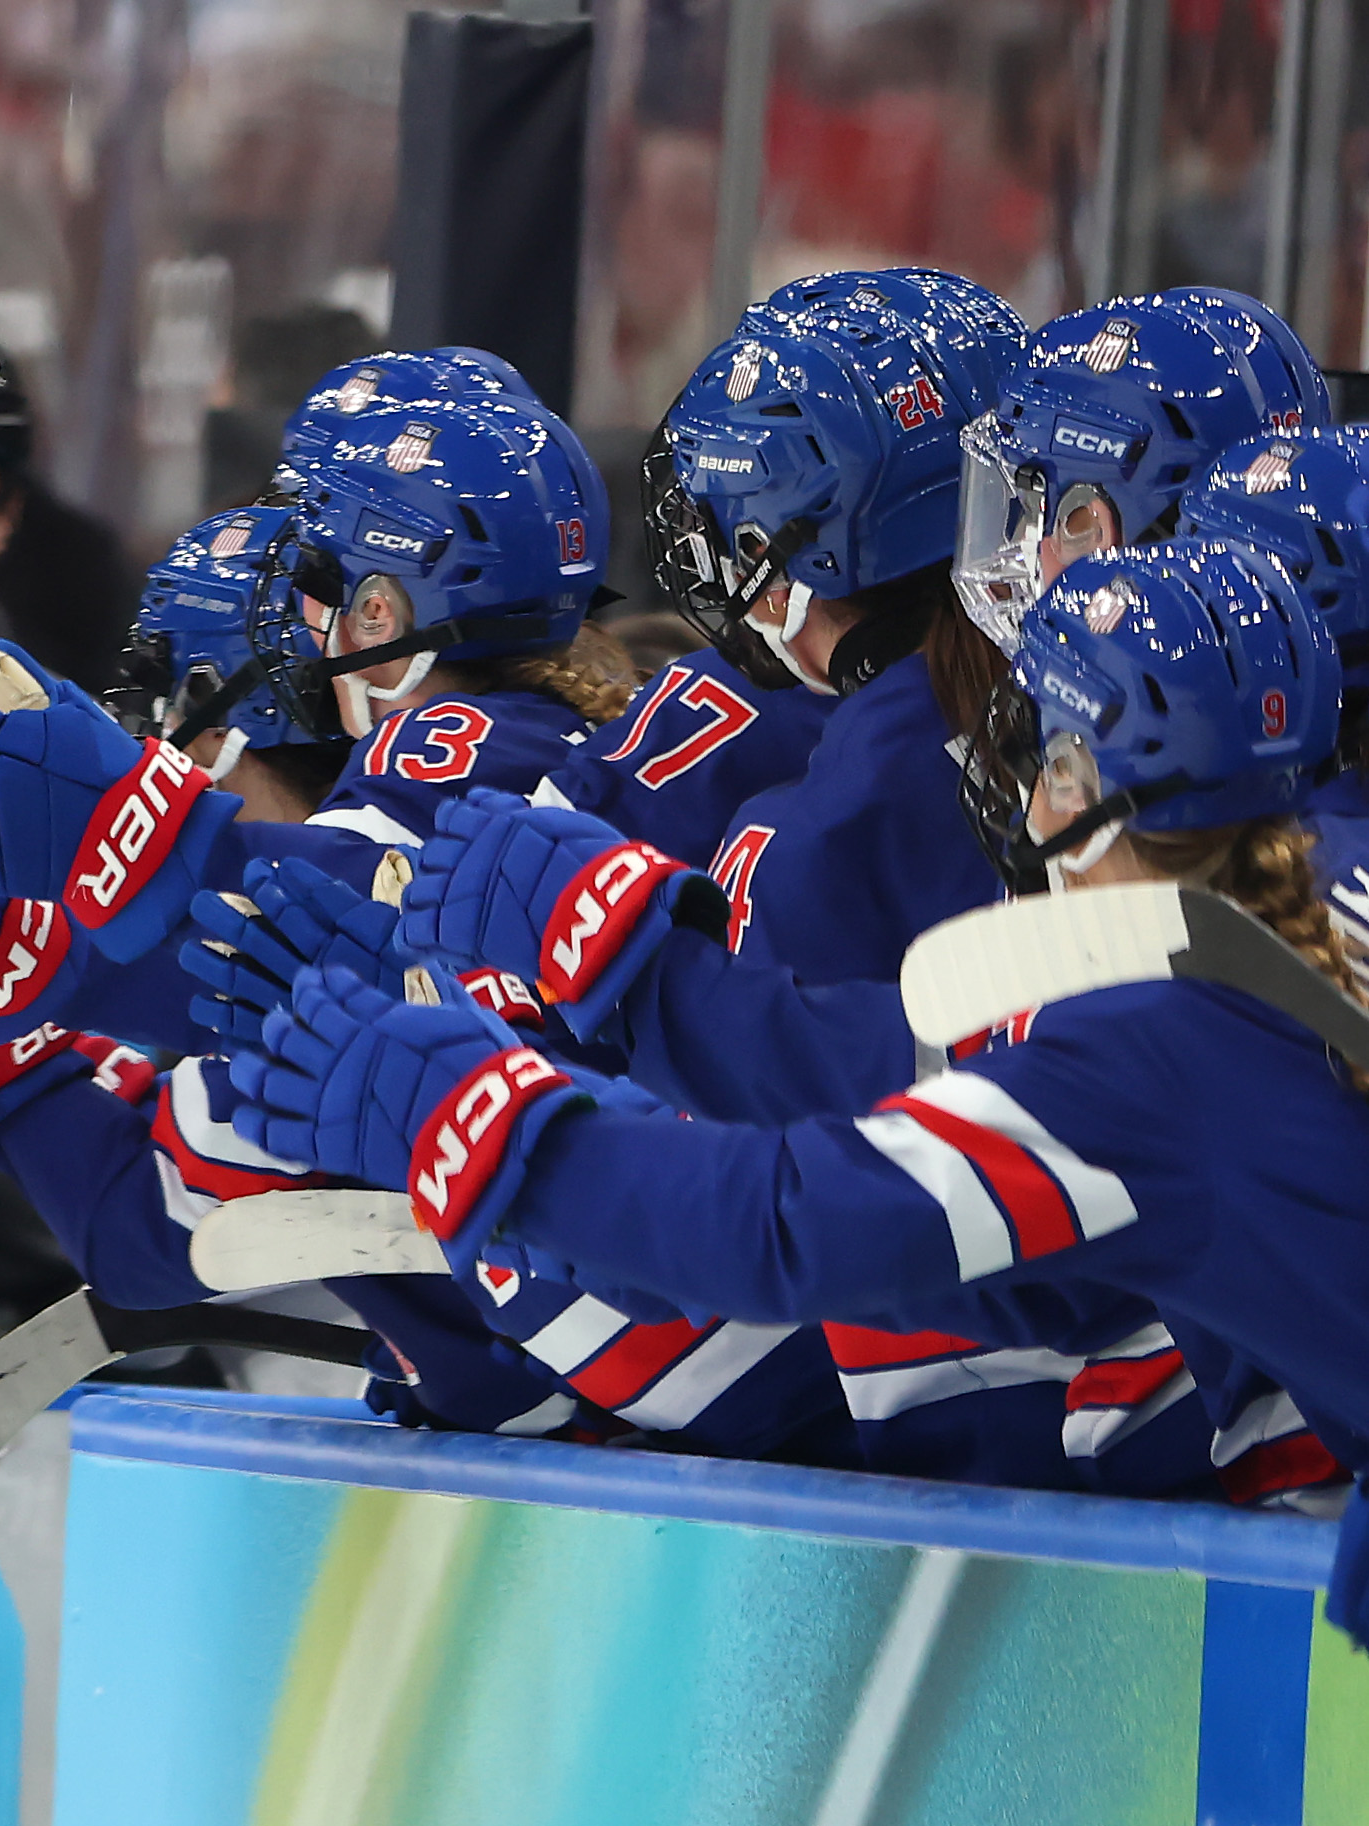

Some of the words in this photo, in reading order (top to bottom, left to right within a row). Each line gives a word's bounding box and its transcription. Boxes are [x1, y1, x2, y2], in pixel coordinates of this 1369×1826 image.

[855, 290, 880, 308] USA
[1106, 321, 1130, 337] USA
[889, 376, 944, 432] 24
[406, 424, 432, 438] USA
[1054, 426, 1128, 459] CCM
[363, 529, 425, 554] CCM
[555, 518, 585, 564] 13
[1043, 669, 1103, 722] CCM
[1262, 688, 1286, 738] 9
[363, 701, 495, 784] 13
[600, 665, 760, 792] 17
[76, 740, 194, 908] AUER
[708, 823, 777, 956] 4
[416, 1050, 558, 1217] CCM
